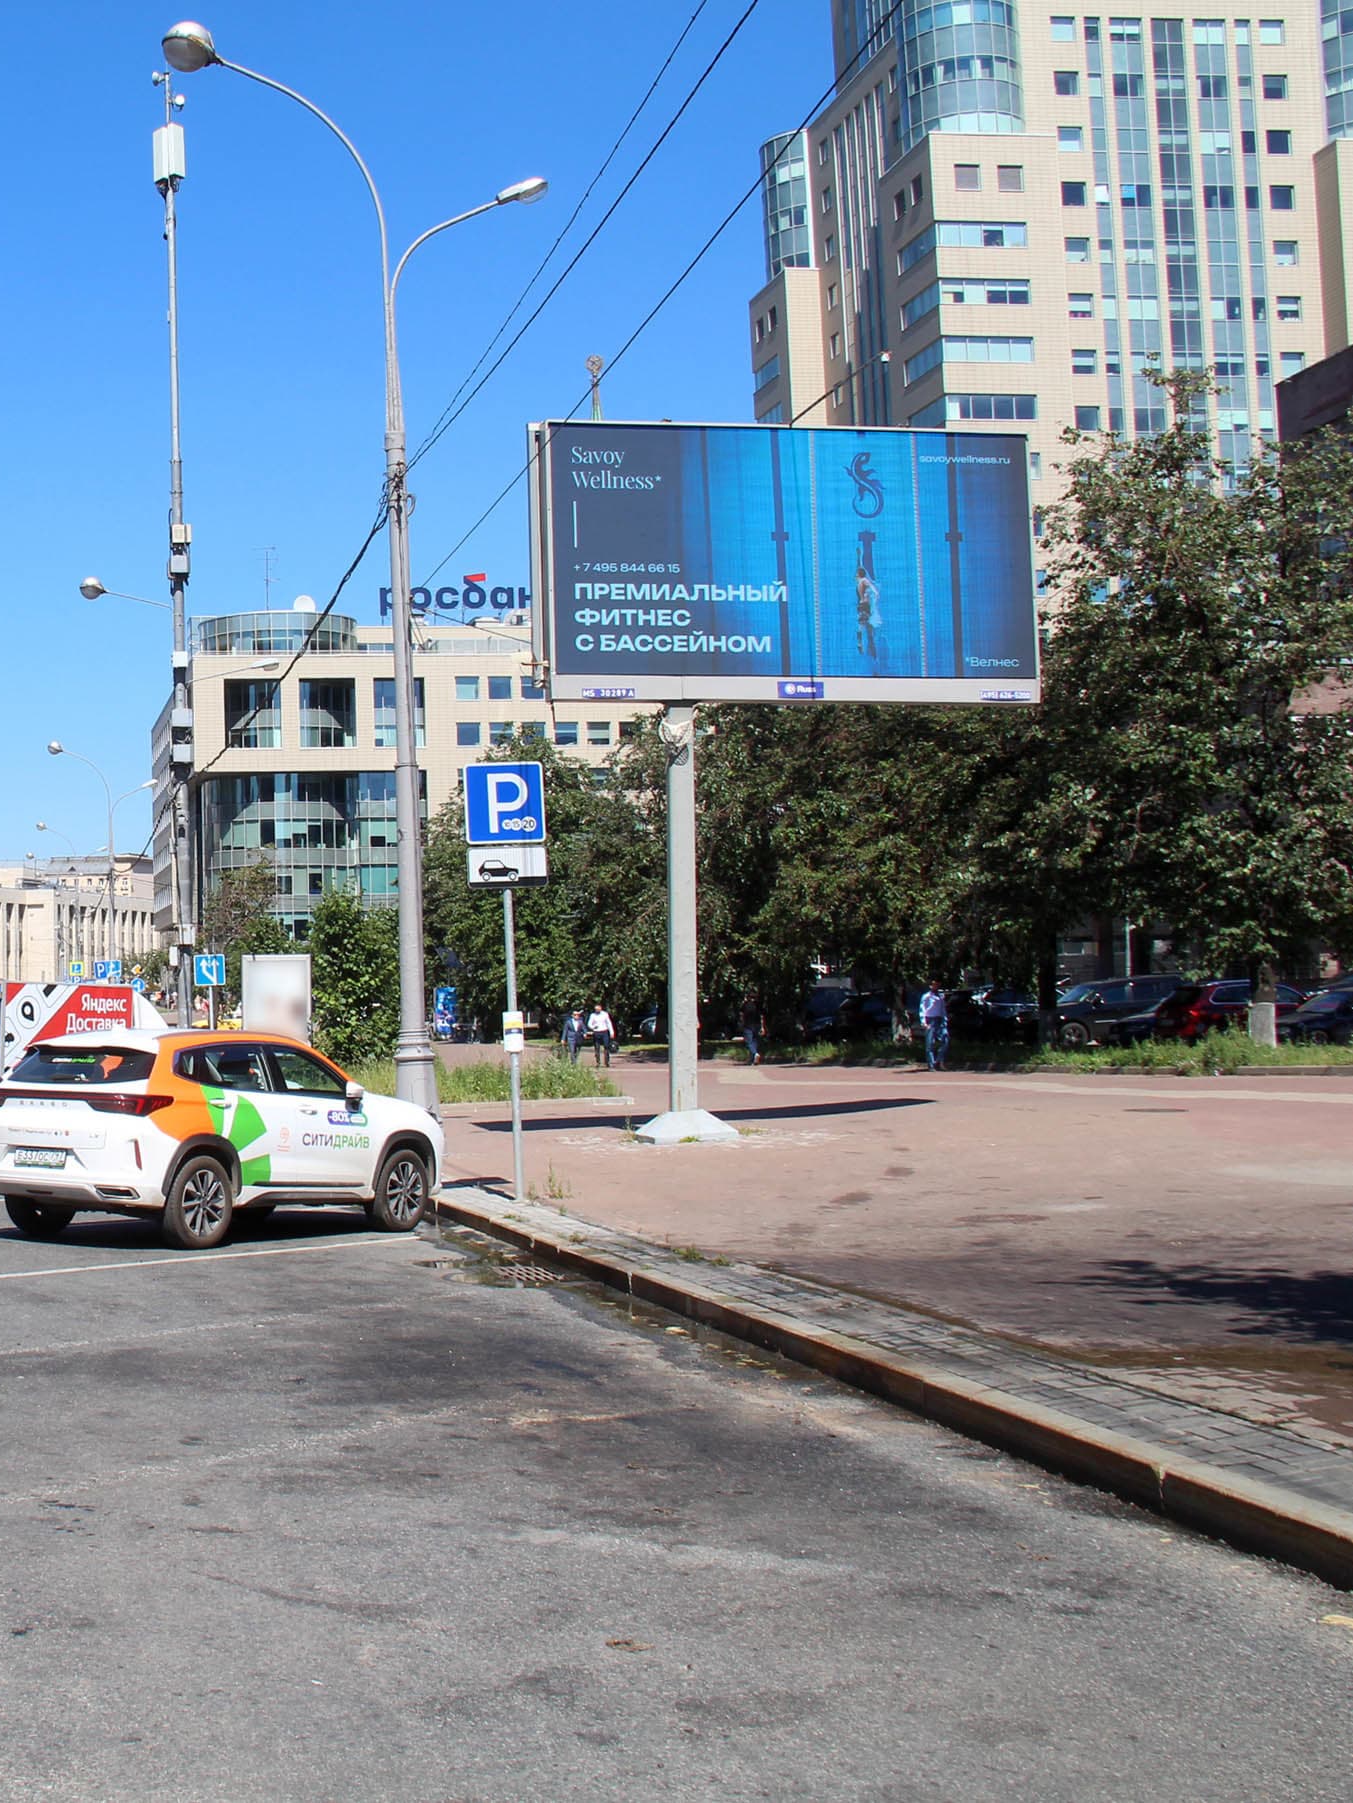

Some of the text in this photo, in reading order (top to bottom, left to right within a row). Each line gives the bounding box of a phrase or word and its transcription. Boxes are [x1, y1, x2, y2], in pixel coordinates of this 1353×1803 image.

[571, 446, 625, 468] Savoy
[919, 455, 1011, 465] savoywellness.ru
[593, 563, 618, 573] 495
[620, 563, 645, 573] 844
[647, 564, 665, 573] 66
[667, 564, 681, 574] 15
[574, 579, 788, 602] ПРЕМИАЛЬНЫЙ
[574, 607, 692, 626] ФИТНЕС
[575, 631, 772, 653] С БАССЕЙНОМ
[487, 772, 528, 834] P
[523, 819, 535, 829] 20
[97, 963, 105, 979] P
[81, 993, 127, 1014] Яндекс
[302, 1132, 370, 1150] СИТИДРАЙВ
